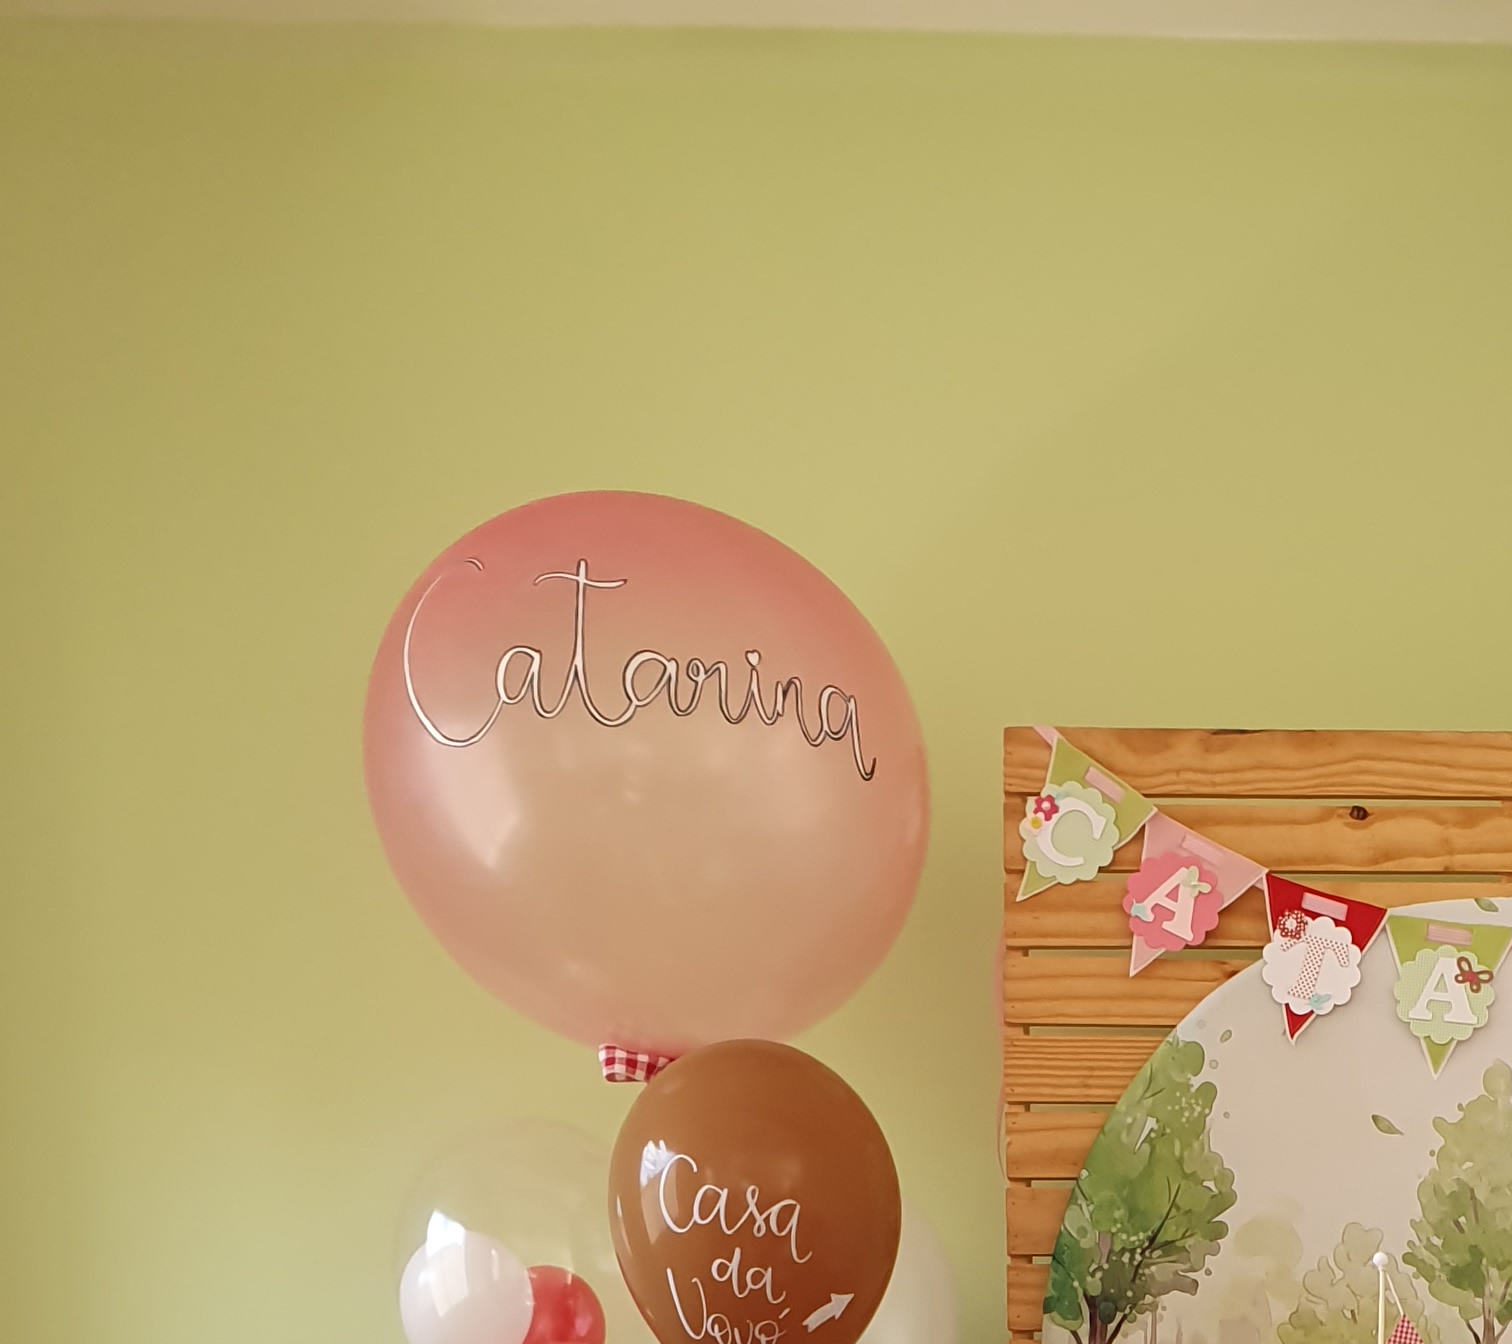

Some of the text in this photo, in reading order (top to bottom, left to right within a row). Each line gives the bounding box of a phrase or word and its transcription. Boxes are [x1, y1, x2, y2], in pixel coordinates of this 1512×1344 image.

[403, 558, 876, 781] Catarina
[659, 1153, 813, 1264] Casa
[711, 1246, 787, 1304] da
